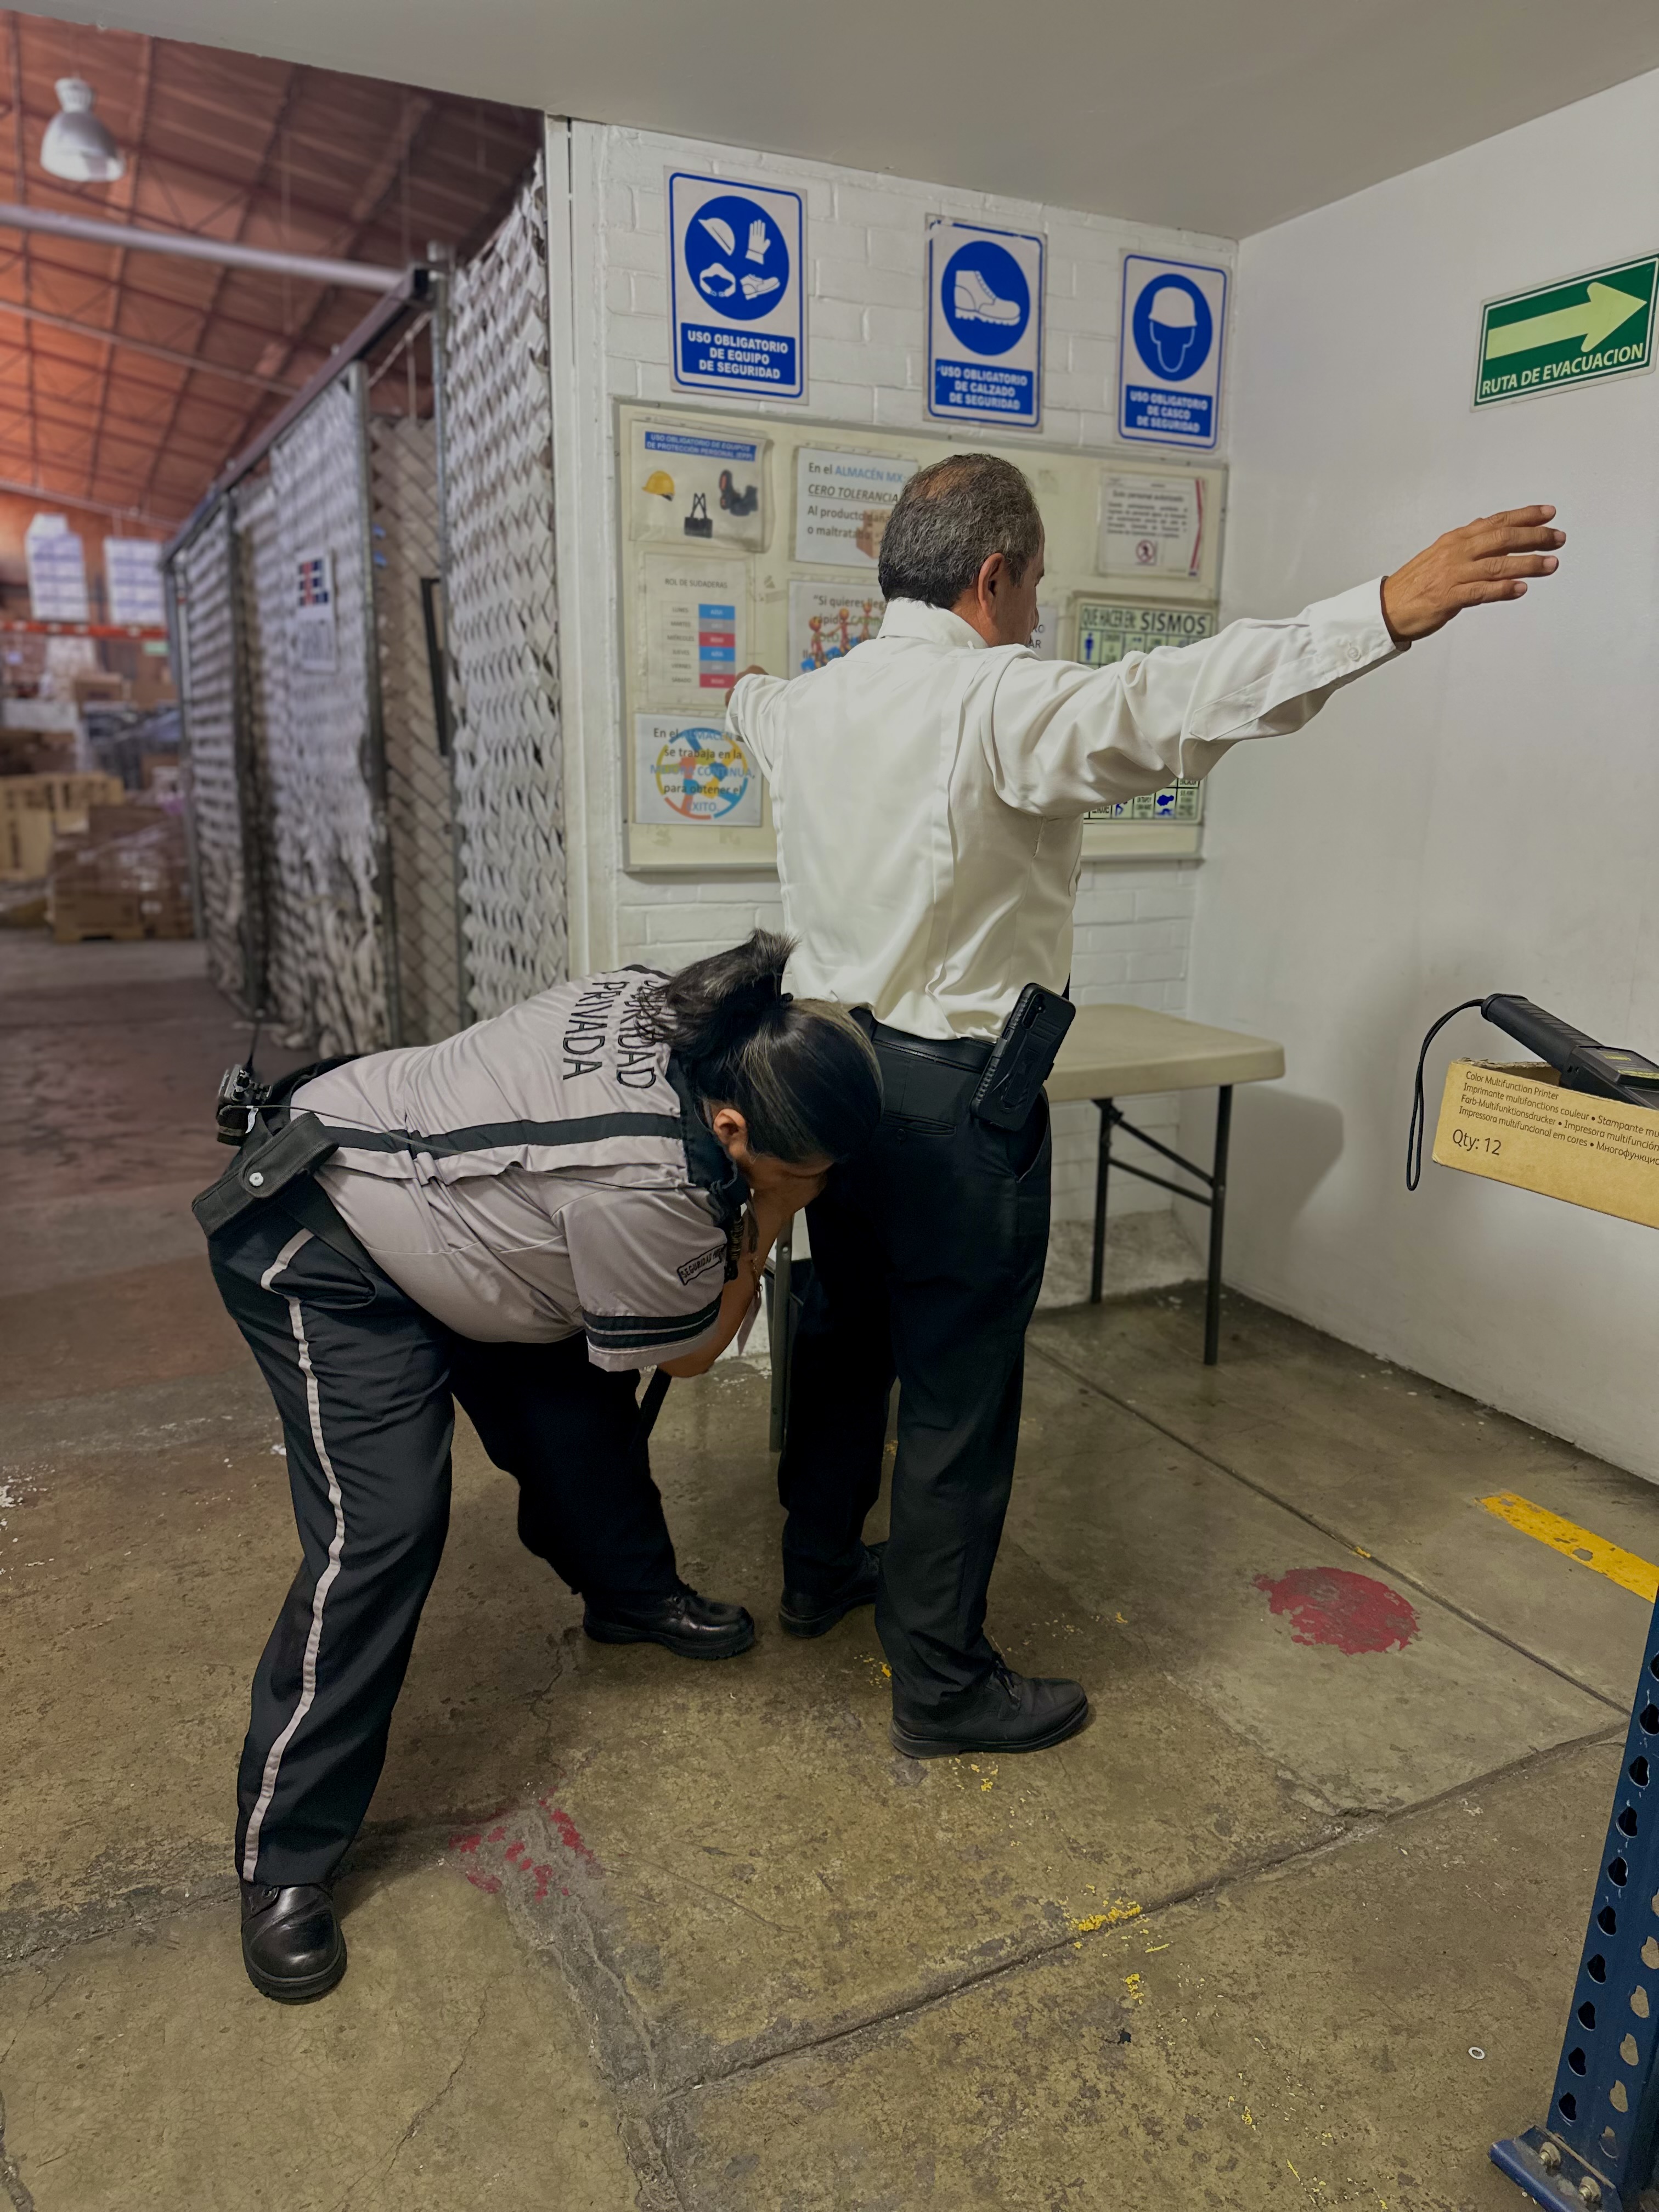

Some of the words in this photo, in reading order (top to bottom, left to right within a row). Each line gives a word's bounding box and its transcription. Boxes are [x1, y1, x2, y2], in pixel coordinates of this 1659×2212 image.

[687, 330, 712, 343] USO
[714, 334, 788, 354] OBLIGATORIO
[709, 347, 725, 359] DE
[727, 349, 770, 365] EQUIPO
[699, 359, 714, 371] DE
[717, 362, 781, 379] SEGURIDAD
[940, 365, 962, 378] USO
[963, 368, 1028, 386] OBLIGATORIO
[1482, 374, 1517, 396] RUTA
[1521, 368, 1541, 386] DE
[1542, 342, 1644, 381] EVACUACION
[954, 380, 968, 392] DE
[970, 382, 1016, 397] CALZADO
[949, 392, 963, 404] DE
[964, 394, 1020, 410] SEGURIDAD
[1130, 390, 1149, 403] USO
[1150, 393, 1208, 411] OBLIGATORIO
[1147, 405, 1160, 416] DE
[1161, 407, 1191, 420] CASCO
[1136, 415, 1149, 427] DE
[1150, 417, 1200, 433] SEGURIDAD
[721, 443, 751, 452] EQUIPOS
[809, 462, 821, 473] En
[823, 465, 833, 475] el
[835, 466, 883, 481] ALMACÉN
[809, 484, 835, 496] CERO
[838, 487, 899, 503] TOLERANCIA
[808, 505, 818, 516] Al
[820, 508, 865, 522] producto
[689, 580, 728, 589] SUDADERAS
[829, 596, 864, 608] quieres
[1141, 612, 1206, 635] SISMOS
[653, 728, 666, 738] En
[669, 729, 679, 738] el
[664, 748, 676, 757] se
[679, 748, 715, 760] trabaja
[733, 749, 742, 759] la
[664, 785, 686, 794] para
[690, 784, 730, 794] obtener
[732, 785, 742, 794] el
[563, 981, 630, 1080] PRIVADA
[1466, 1071, 1484, 1082] Color
[1485, 1075, 1532, 1094] Multifunction
[1534, 1087, 1559, 1101] Printer
[1461, 1094, 1556, 1125] Farb-Multifunktionsdrucker
[1564, 1120, 1605, 1138] Impresora
[1463, 1082, 1505, 1100] Imprimante
[1506, 1095, 1559, 1113] multifonctions
[1560, 1109, 1589, 1121] couleur
[1598, 1115, 1644, 1135] Stampante
[1459, 1105, 1497, 1123] Impressora
[1498, 1119, 1551, 1137] multifuncional
[1553, 1132, 1566, 1141] em
[1567, 1136, 1588, 1147] cores
[1453, 1129, 1480, 1152] Qty:
[1485, 1137, 1502, 1156] 12
[1596, 1141, 1659, 1165] Многофункцио
